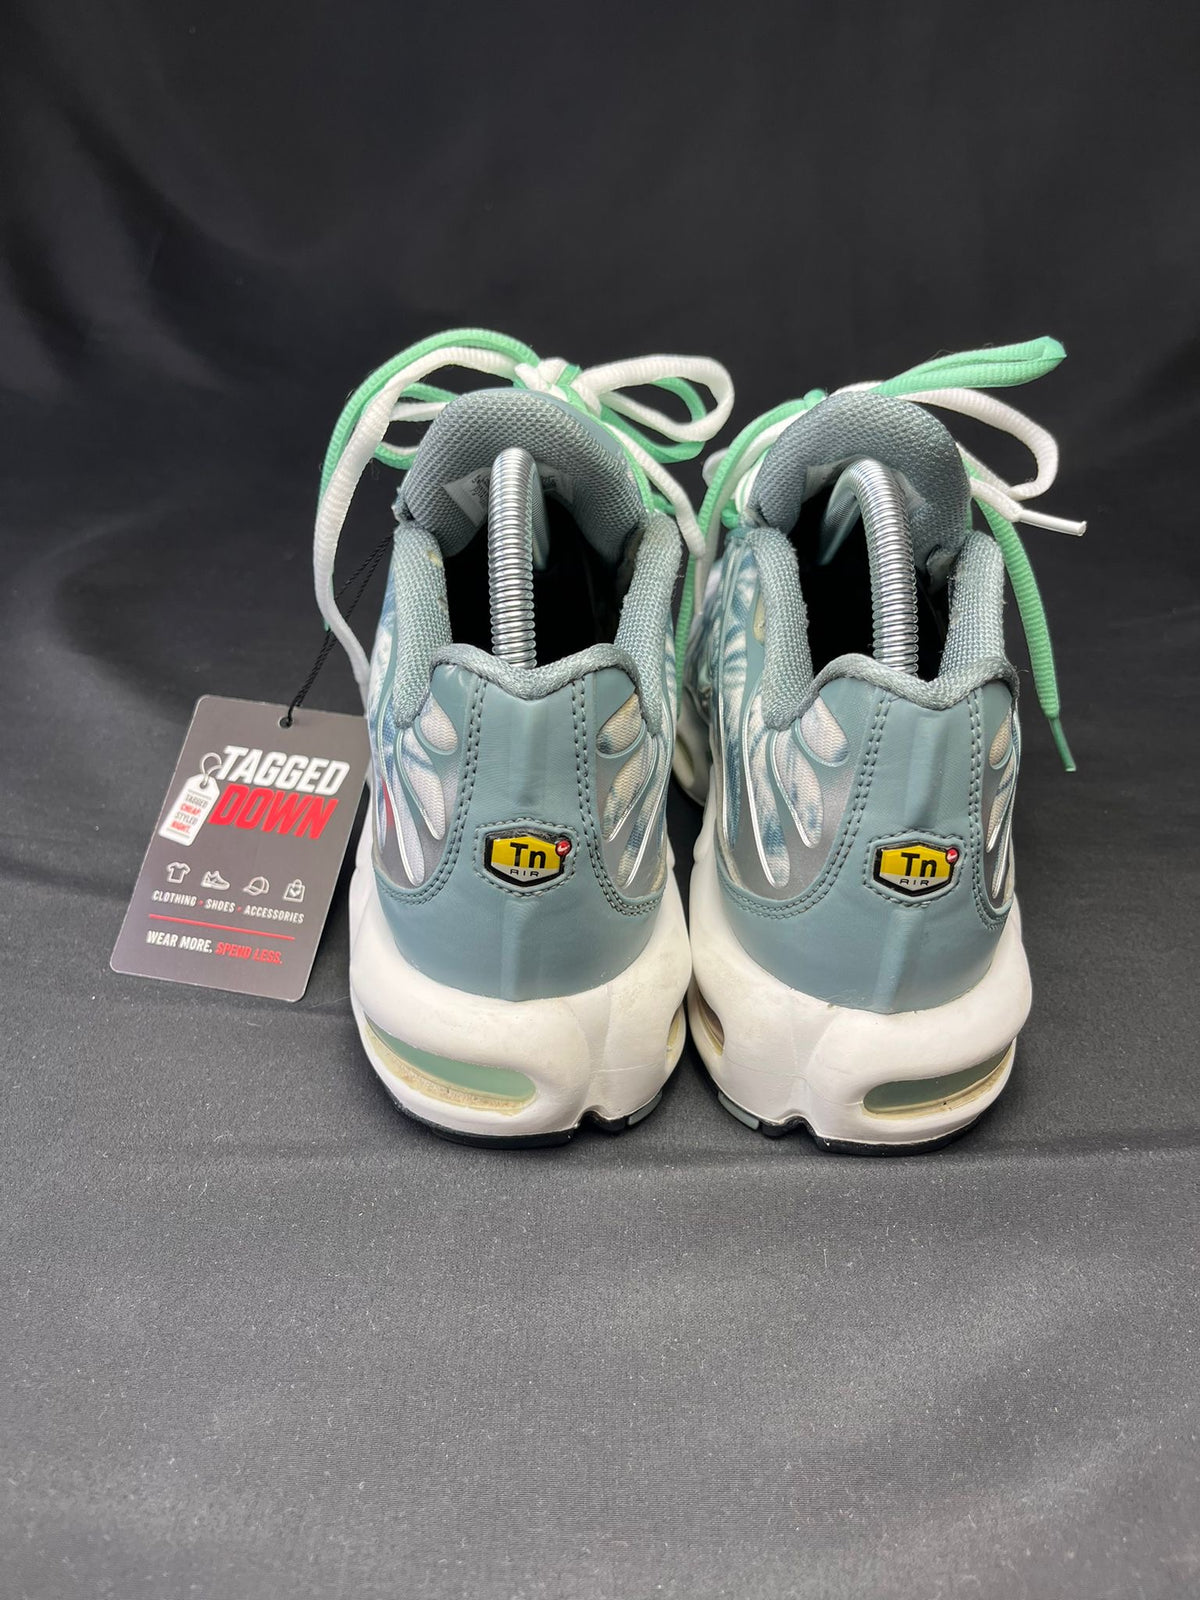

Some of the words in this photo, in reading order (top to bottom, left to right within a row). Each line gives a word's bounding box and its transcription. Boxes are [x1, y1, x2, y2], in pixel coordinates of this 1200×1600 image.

[216, 745, 350, 796] TAGGED
[208, 784, 338, 840] DOWN
[510, 842, 547, 869] Tn
[900, 852, 938, 877] Tn
[509, 868, 540, 877] AIR
[899, 878, 930, 886] AIR
[152, 889, 198, 907] CLOTHING
[205, 898, 236, 913] SHOES
[243, 904, 305, 924] ACCESSORIES
[146, 930, 179, 948] WEAR
[179, 935, 213, 954] MORE,
[215, 942, 252, 960] SPEND
[253, 948, 284, 965] LESS.
